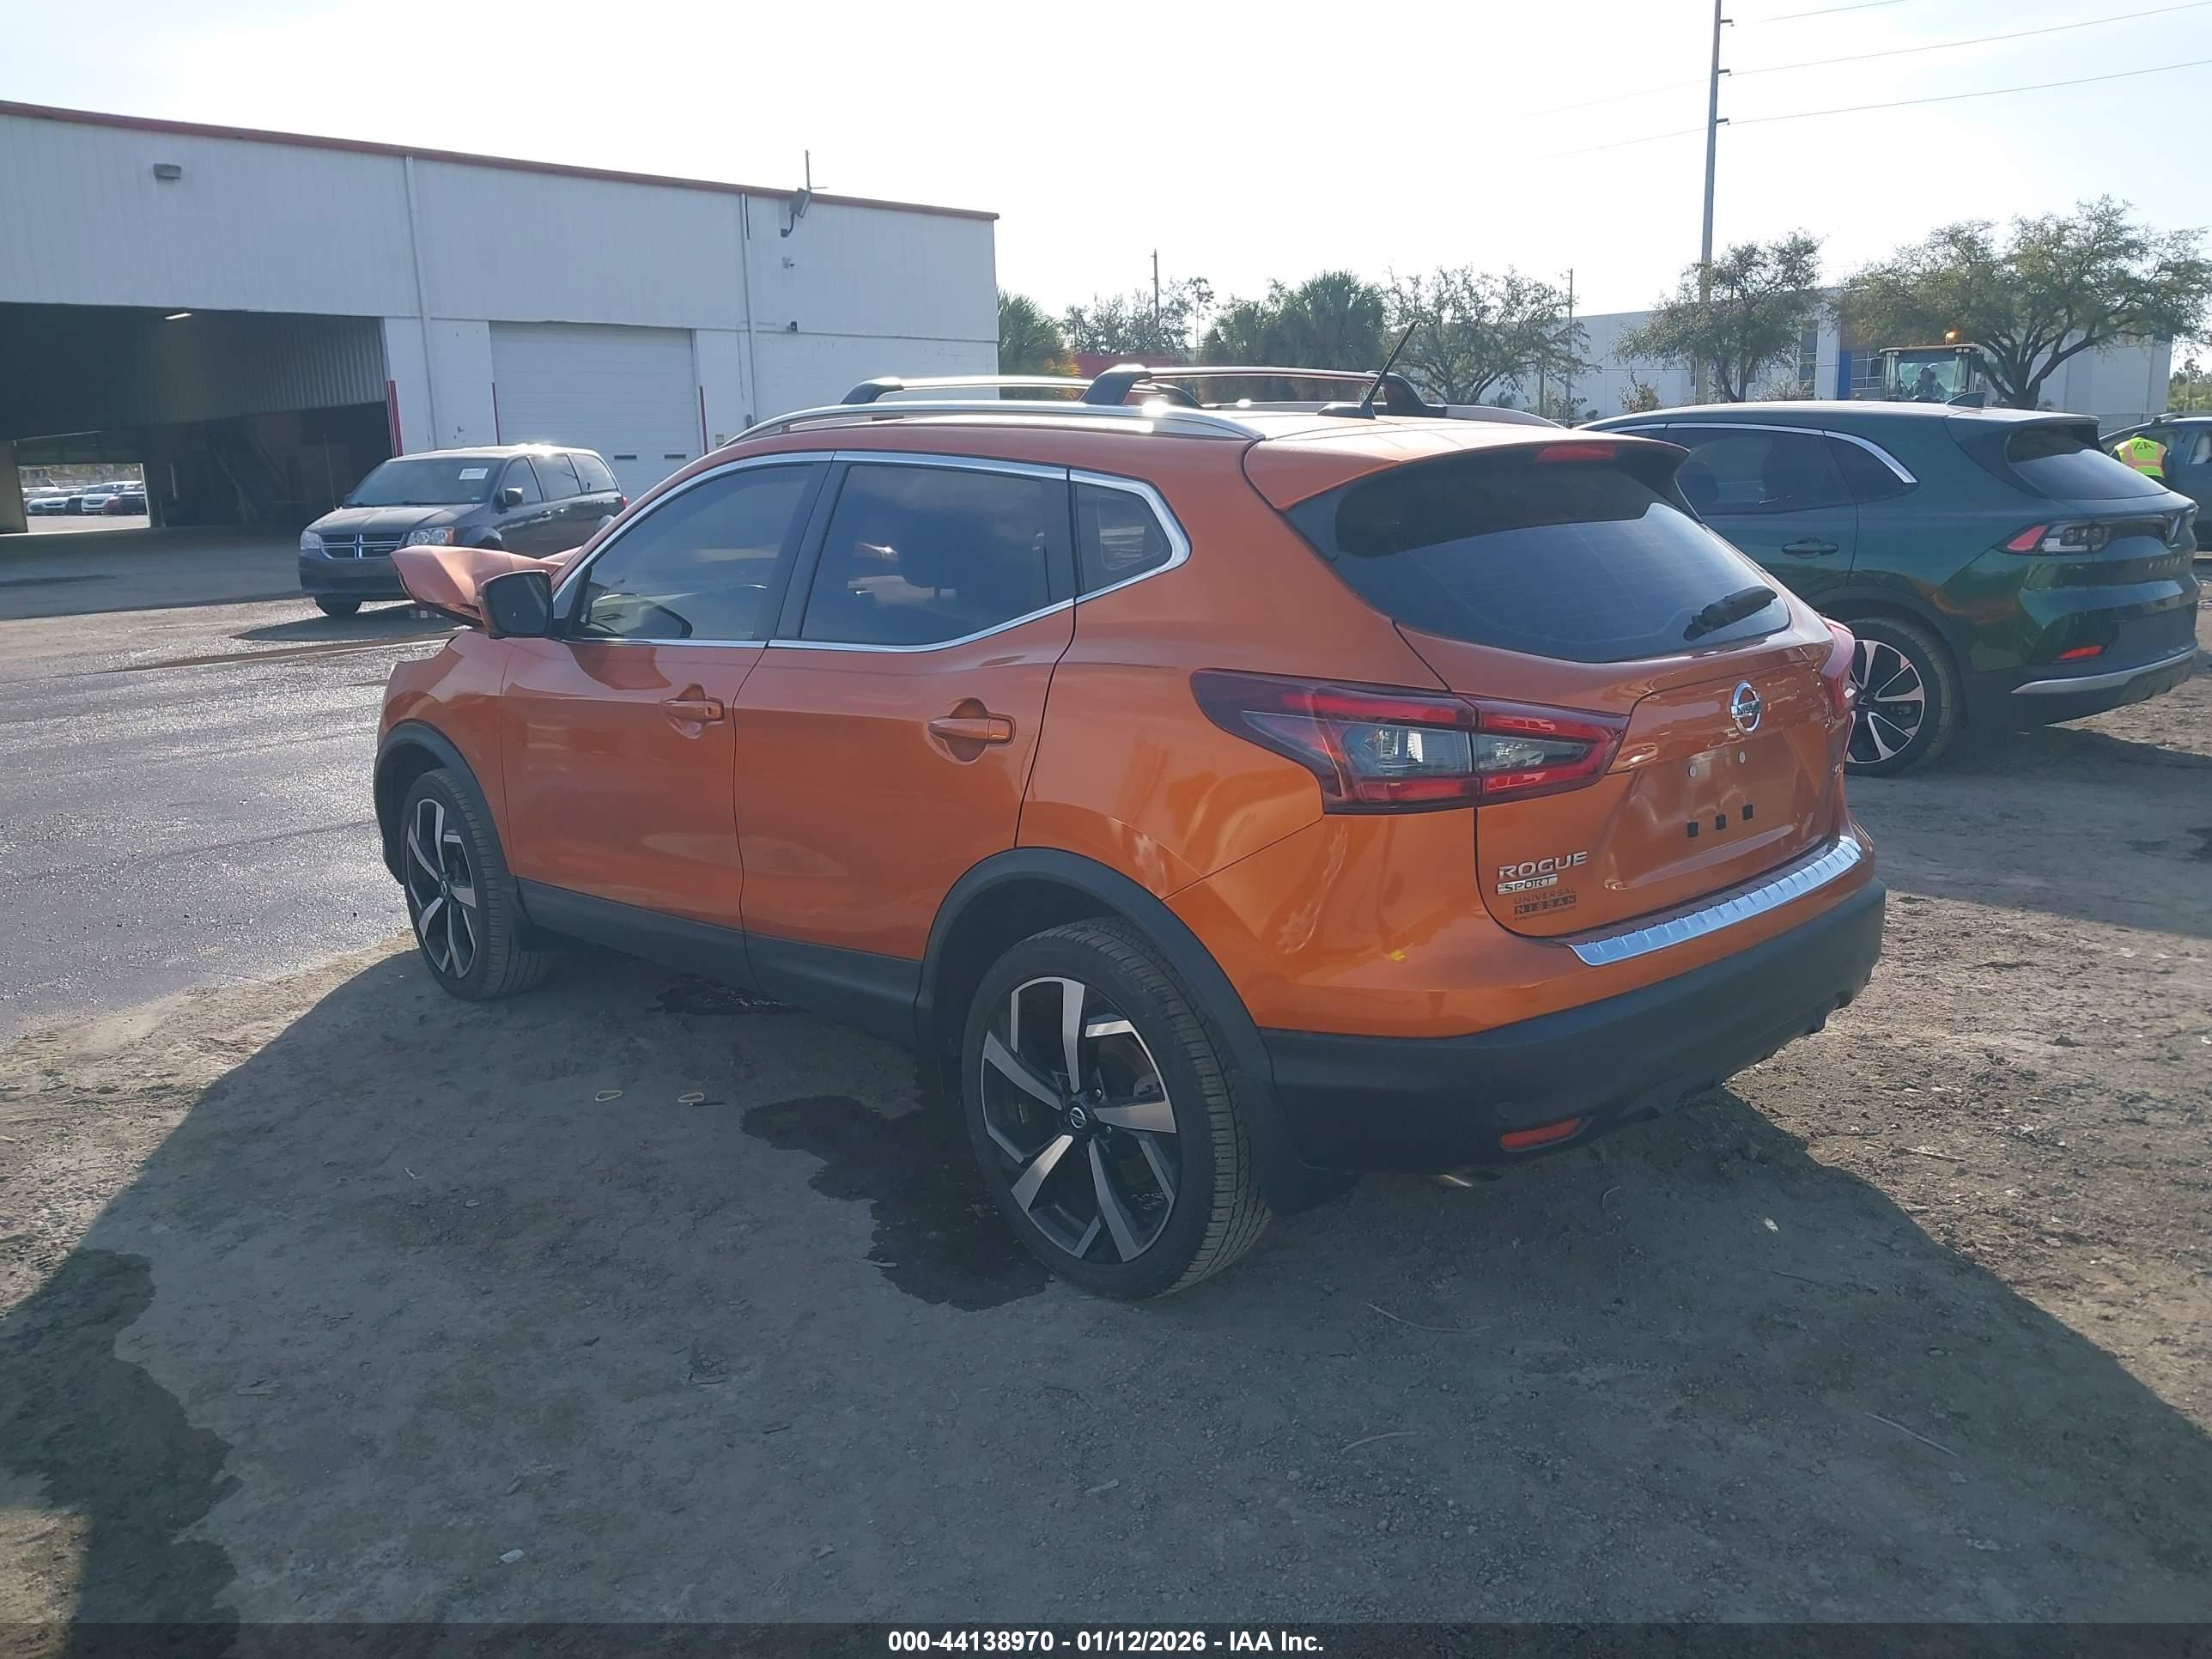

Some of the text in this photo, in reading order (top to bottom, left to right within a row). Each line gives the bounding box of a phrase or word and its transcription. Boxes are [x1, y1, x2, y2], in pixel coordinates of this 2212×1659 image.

[1498, 851, 1588, 880] ROGUE
[1503, 877, 1552, 893] SPORT
[1514, 887, 1577, 904] UNIVERSAL
